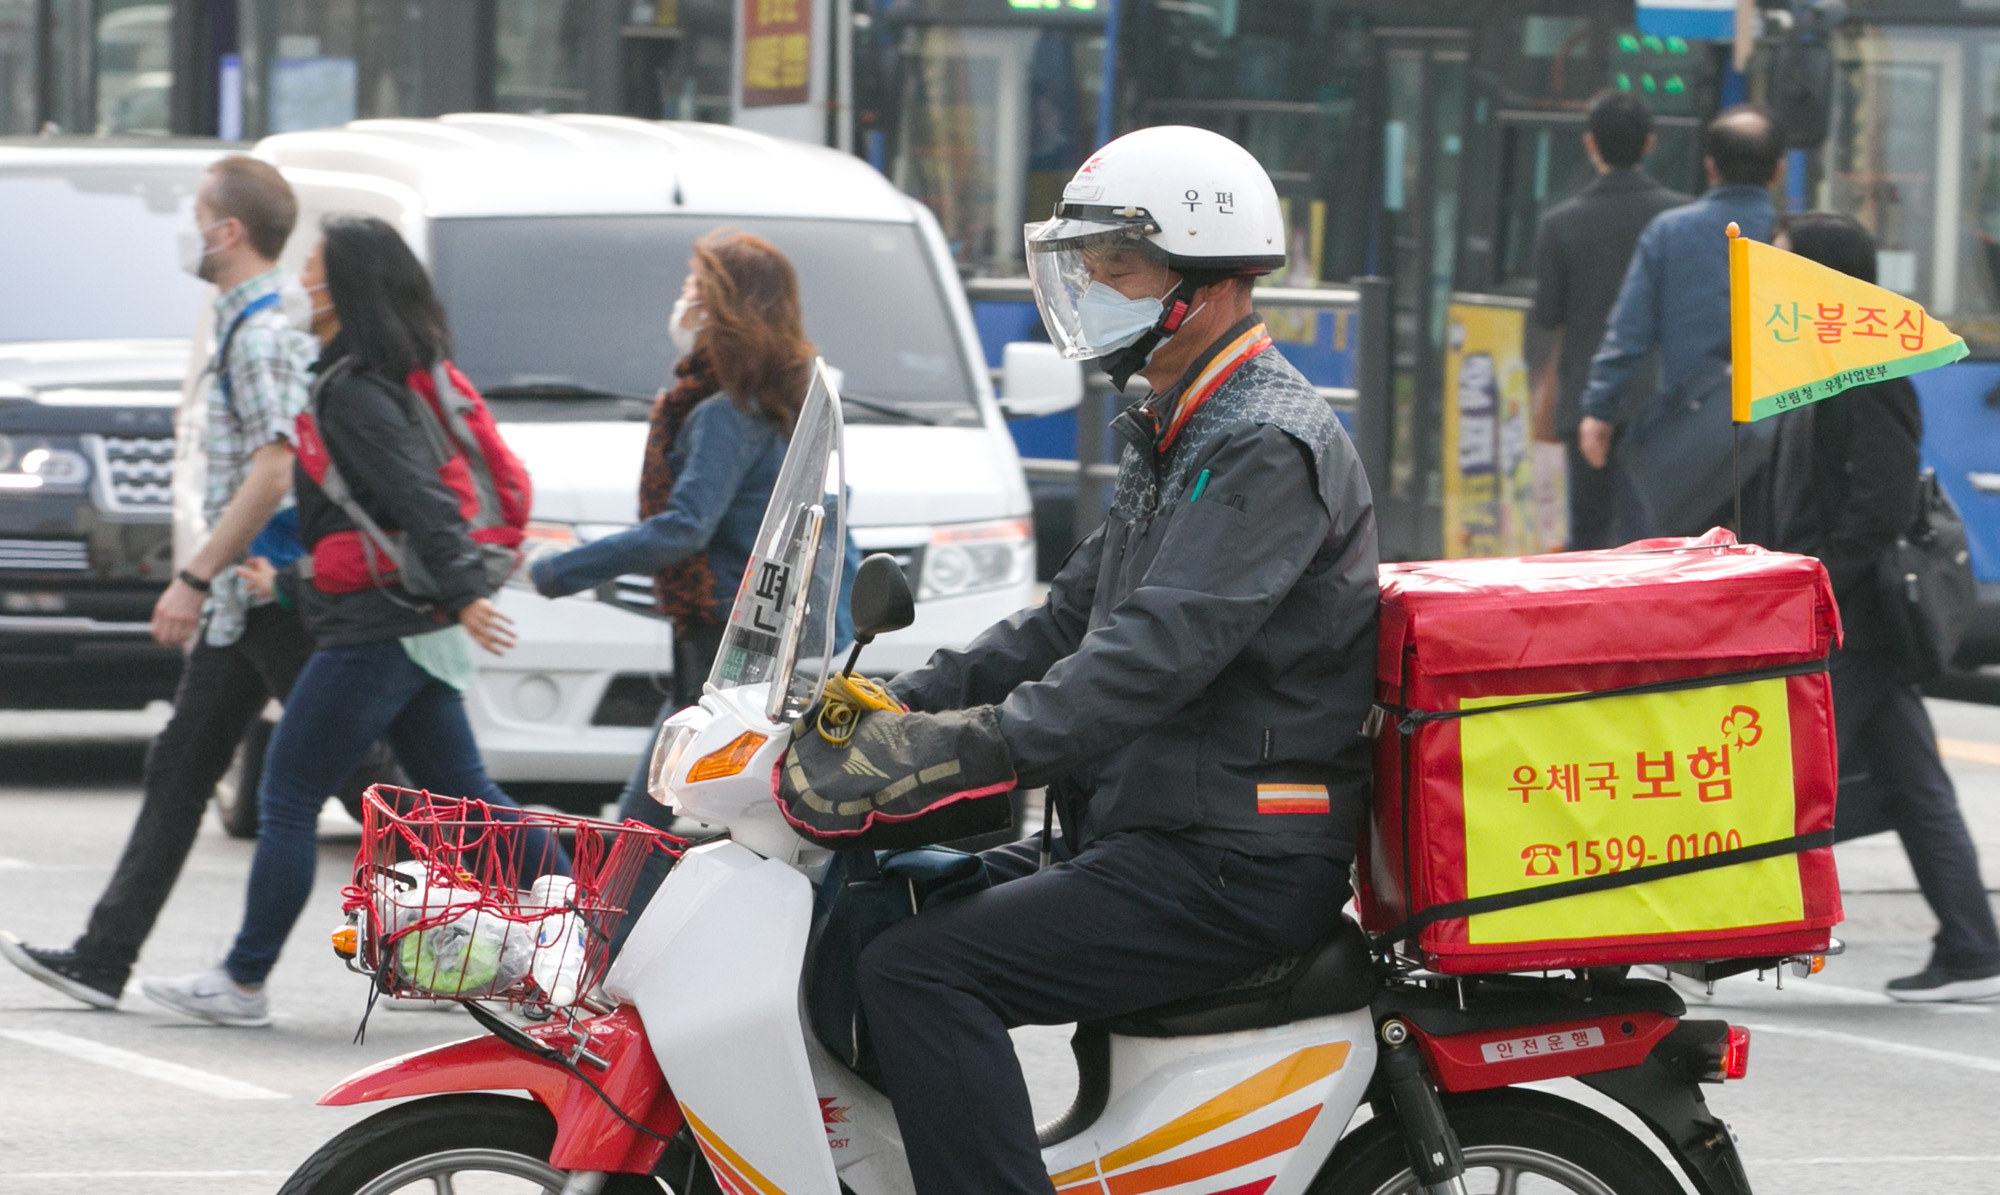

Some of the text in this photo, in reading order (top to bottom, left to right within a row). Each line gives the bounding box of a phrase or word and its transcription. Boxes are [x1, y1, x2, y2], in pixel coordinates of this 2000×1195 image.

[1181, 189, 1234, 214] 우편
[1765, 301, 1925, 351] 산불조심
[1775, 386, 1814, 410] 산림청
[753, 561, 790, 633] 편
[1507, 743, 1733, 803] 우체국 보험
[1496, 1030, 1590, 1059] 안전운행
[829, 1138, 850, 1149] OST
